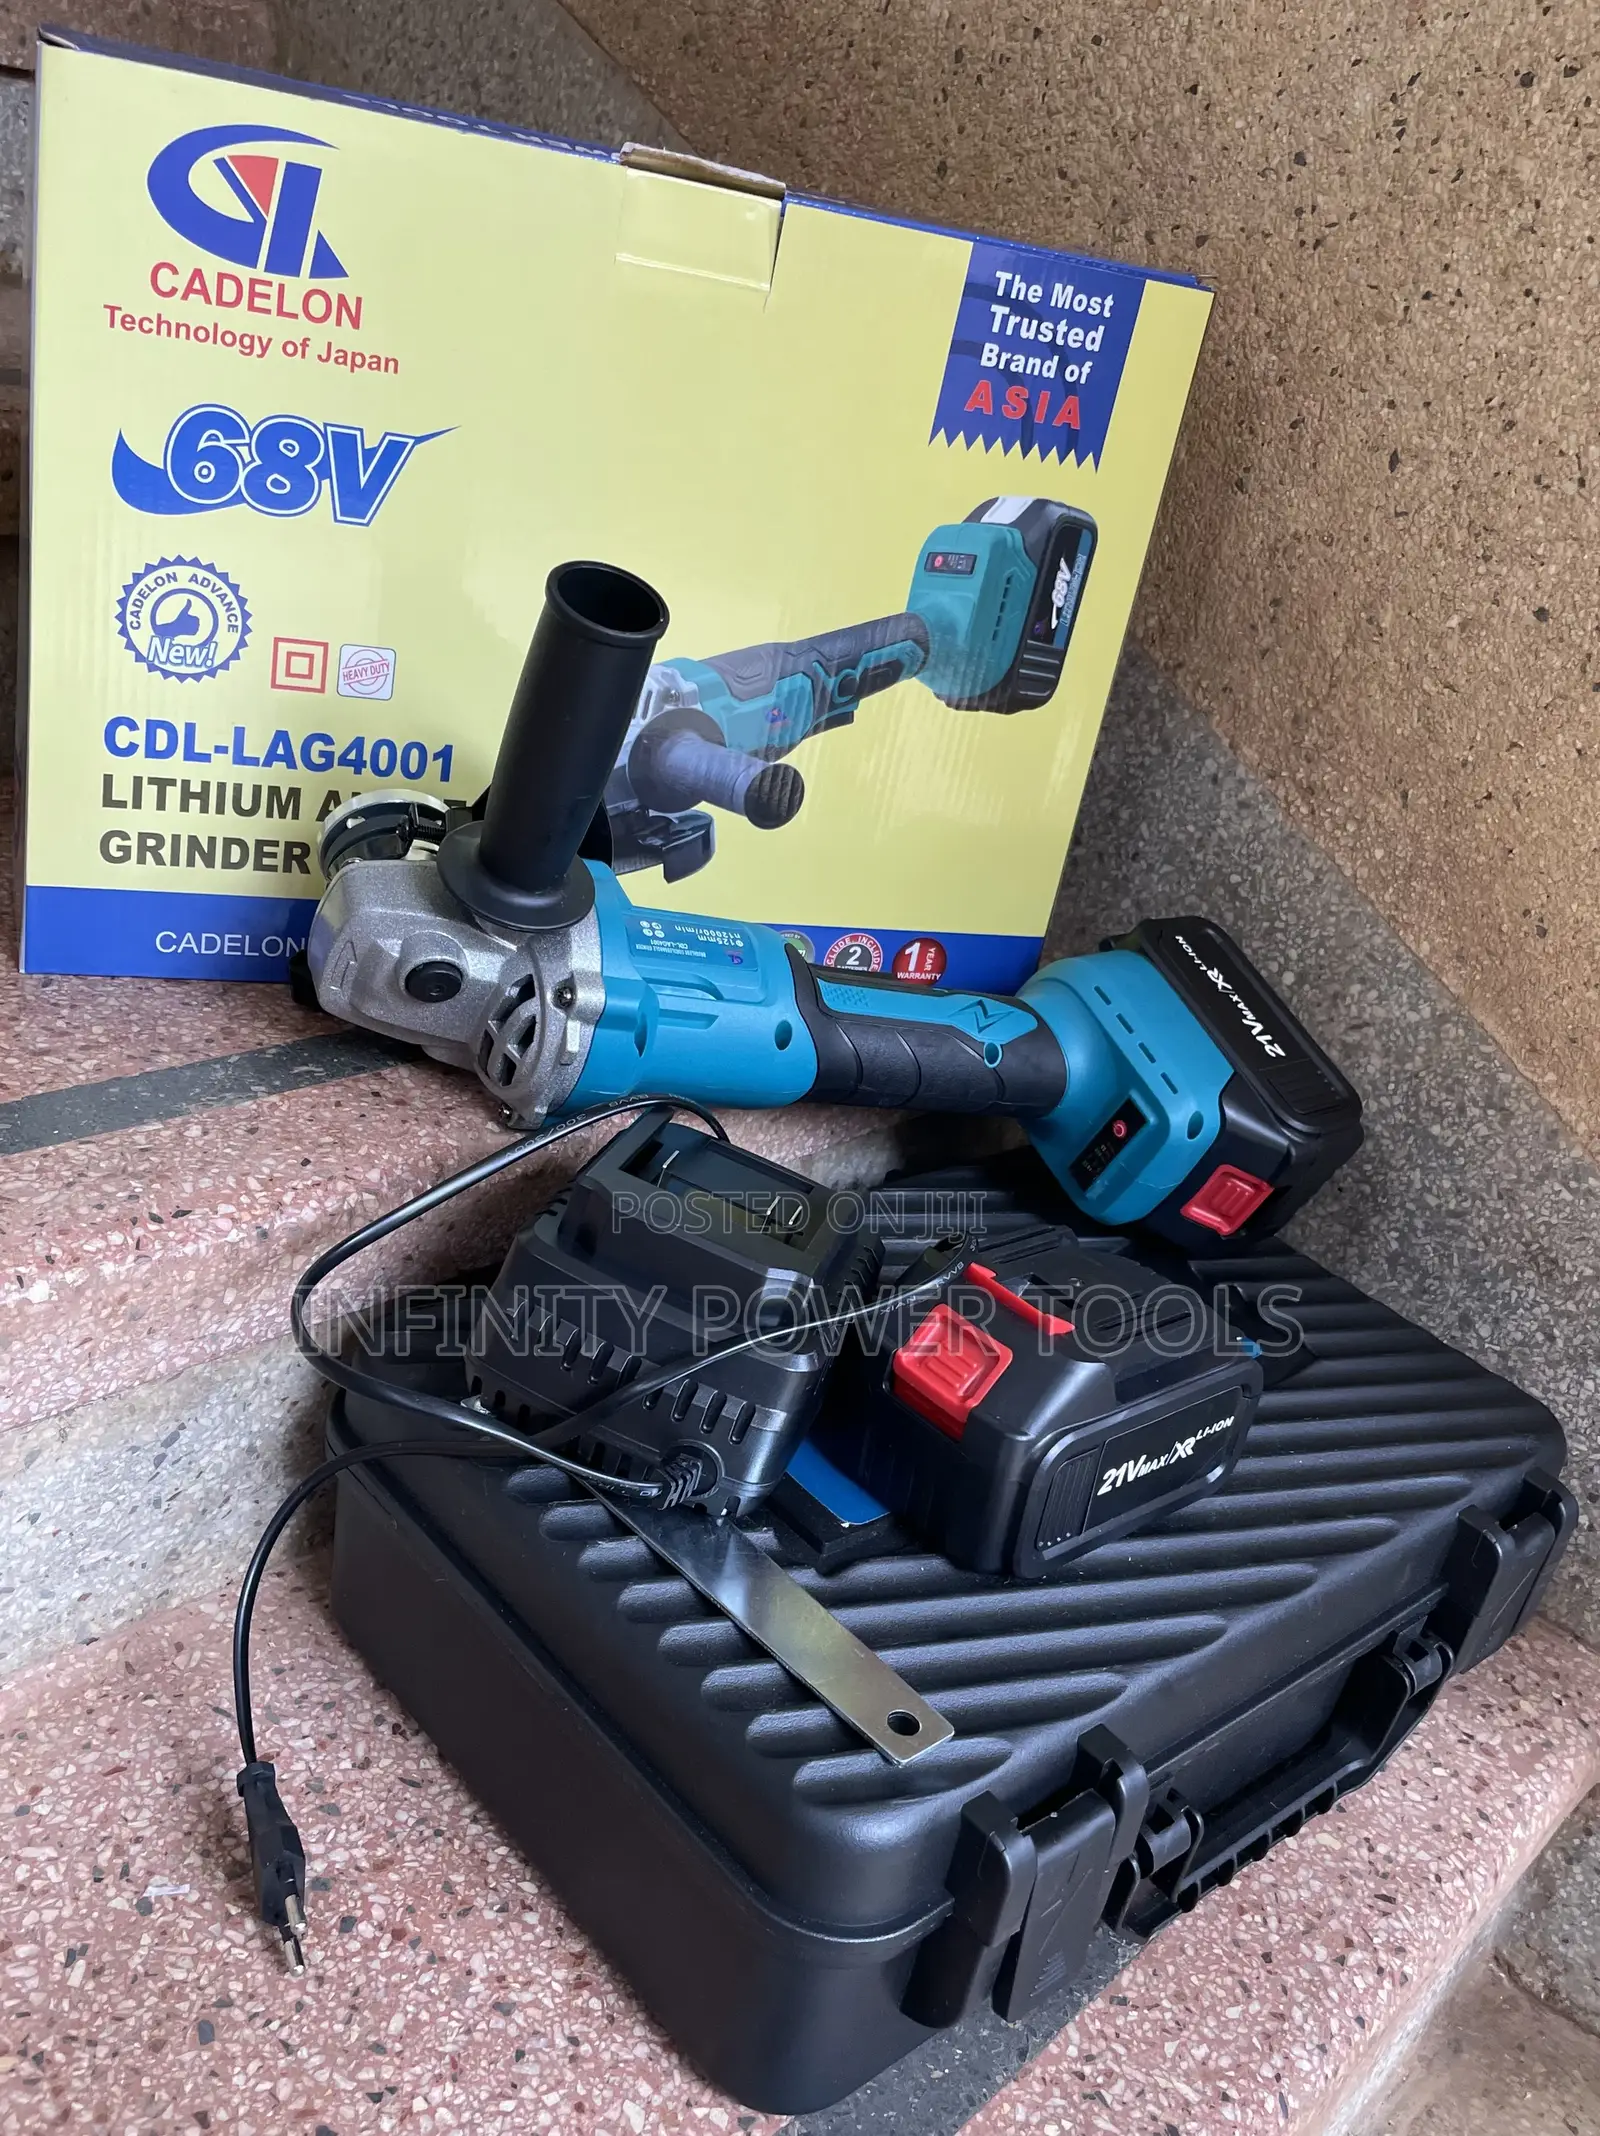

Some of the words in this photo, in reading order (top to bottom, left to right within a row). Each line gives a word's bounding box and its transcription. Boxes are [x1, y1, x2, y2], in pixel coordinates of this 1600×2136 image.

[150, 261, 363, 331] CADELON
[995, 270, 1043, 303] The
[1049, 282, 1114, 318] Most
[102, 304, 273, 359] Technology
[281, 337, 311, 359] of
[317, 341, 399, 375] Japan
[990, 304, 1105, 352] Trusted
[980, 342, 1060, 379] Brand
[1064, 360, 1093, 384] of
[963, 379, 1081, 430] ASIA
[163, 403, 418, 527] 68V
[129, 570, 178, 631] CADELON
[187, 572, 239, 634] ADVANCE
[147, 635, 218, 668] New!
[342, 665, 369, 682] HEAVY
[369, 660, 391, 678] DUTY
[103, 716, 454, 783] CDL-LAG4001
[101, 773, 302, 820] LITHIUM
[100, 829, 311, 875] GRINDER
[155, 931, 305, 958] CADELON
[845, 945, 862, 966] 2
[904, 941, 922, 972] 1
[923, 946, 937, 972] YEAR
[896, 971, 942, 981] WARRANTY
[1195, 1415, 1235, 1441] LI-ION
